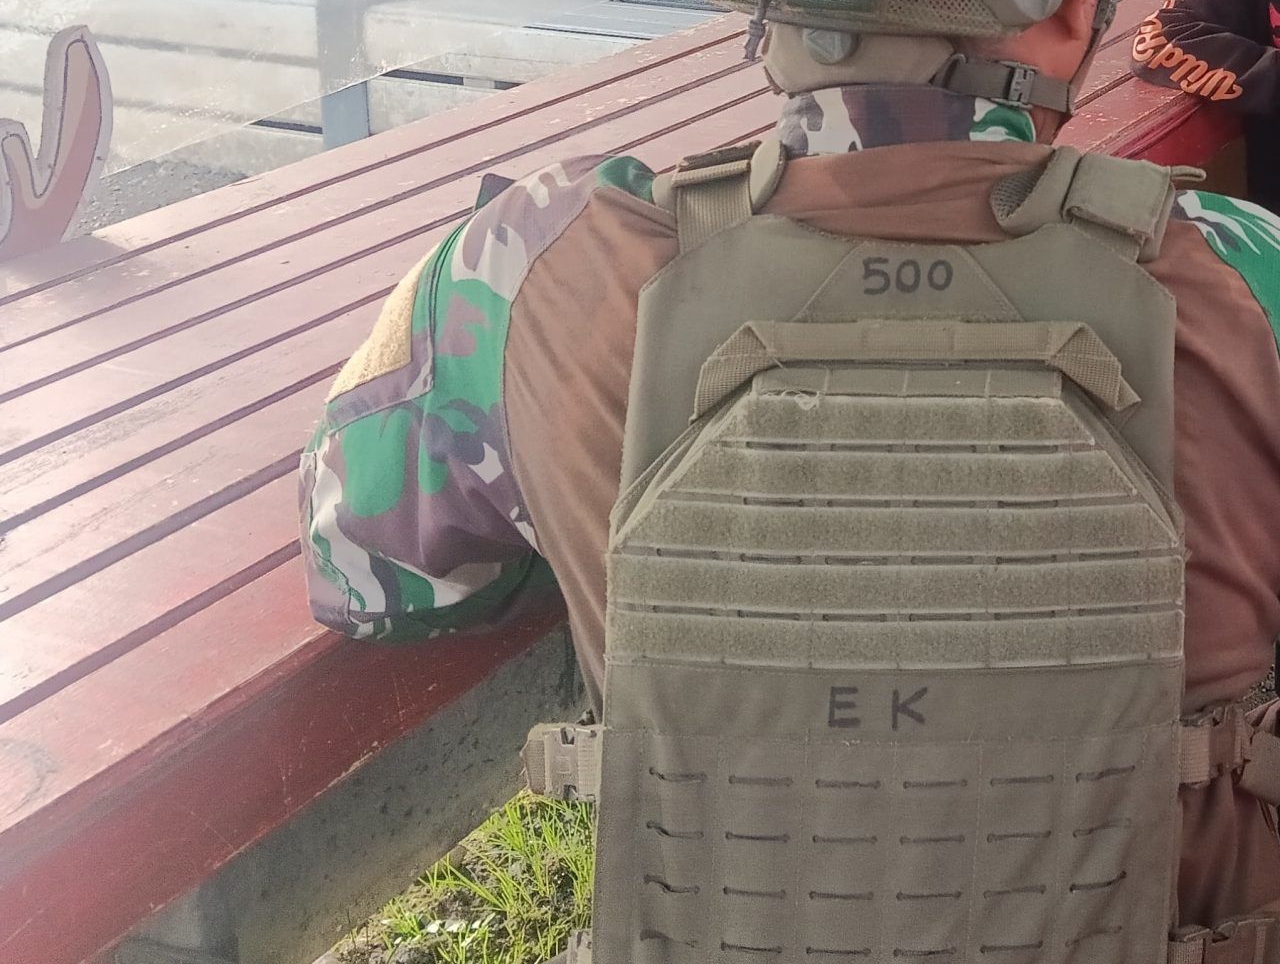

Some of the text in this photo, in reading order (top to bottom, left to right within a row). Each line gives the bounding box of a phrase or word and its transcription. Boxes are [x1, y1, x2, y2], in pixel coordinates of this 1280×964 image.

[862, 256, 954, 295] 500
[827, 686, 928, 732] E K
